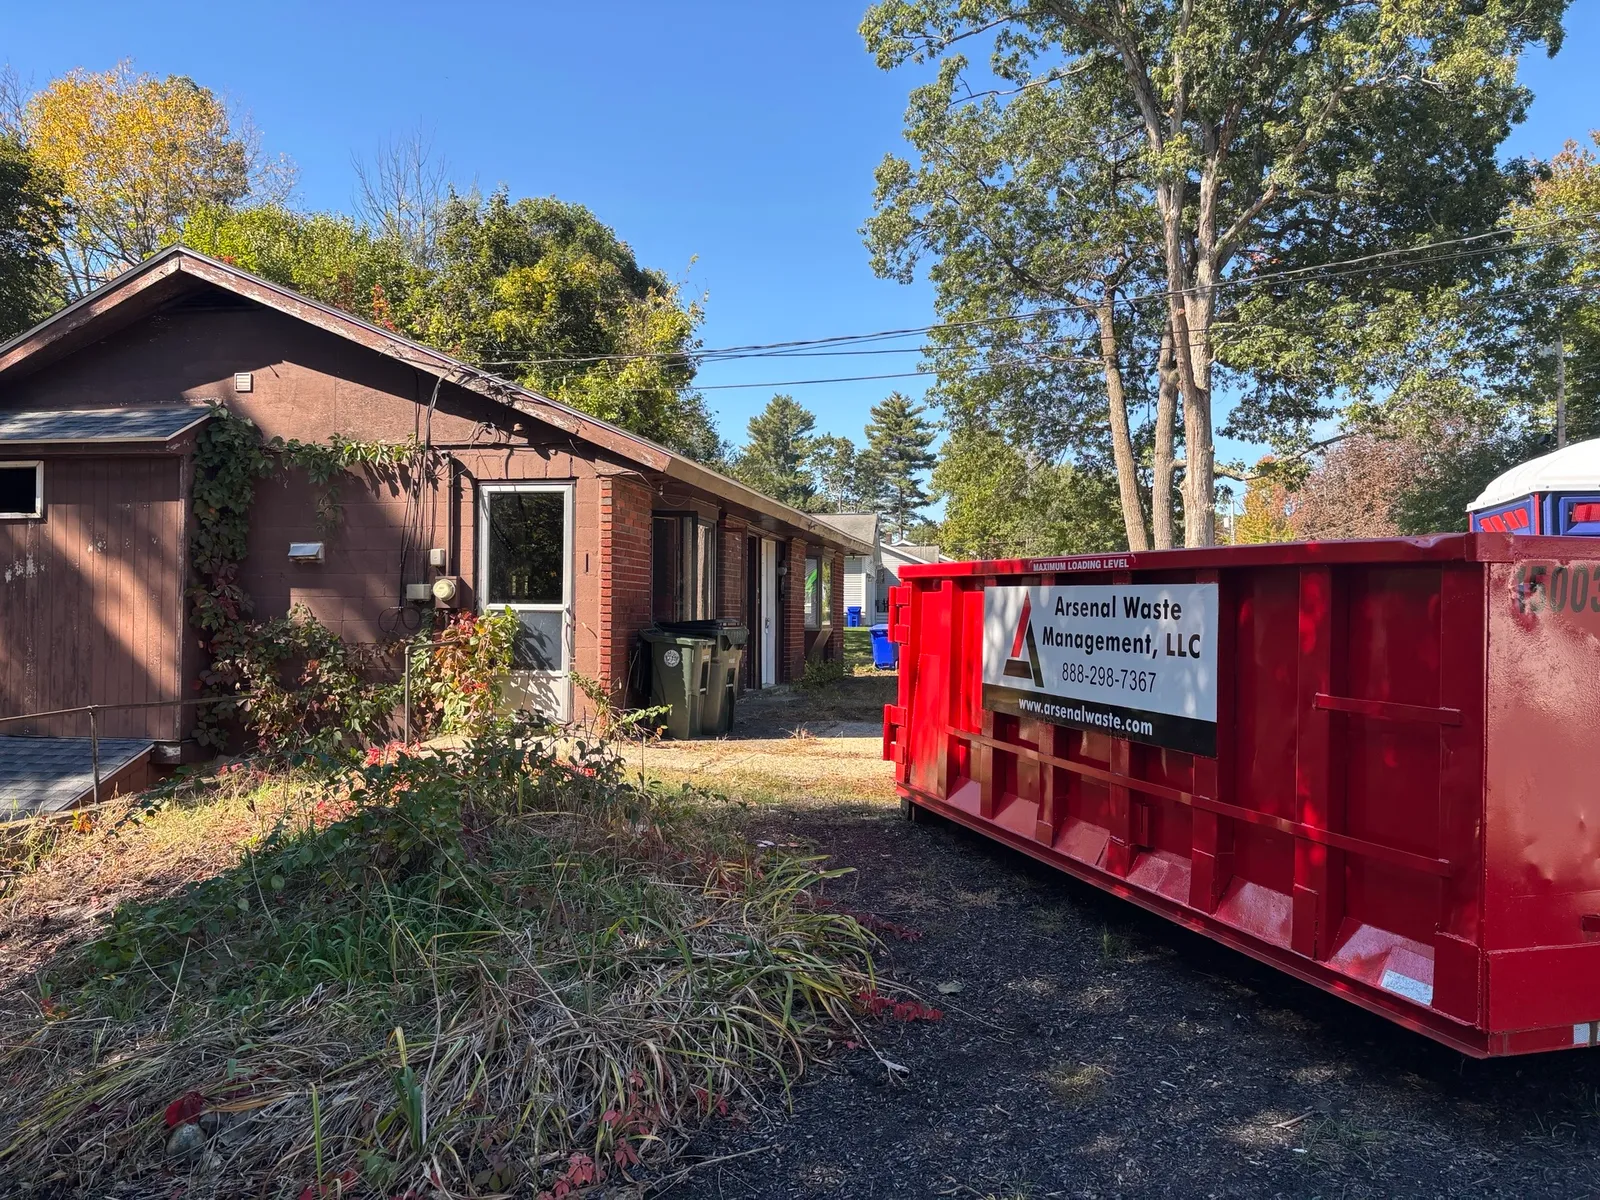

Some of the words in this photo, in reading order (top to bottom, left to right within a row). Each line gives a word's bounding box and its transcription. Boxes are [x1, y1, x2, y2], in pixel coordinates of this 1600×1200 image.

[1033, 562, 1066, 571] MAXIMUM
[1067, 561, 1101, 570] LOADING
[1103, 558, 1129, 569] LEVEL
[1055, 595, 1116, 618] Arsenal
[1123, 596, 1182, 620] Waste
[1042, 626, 1157, 659] Management,
[1166, 633, 1201, 659] LLC
[1062, 662, 1157, 693] 888-298-7367
[1018, 698, 1153, 736] www.arsenalwaste.com
